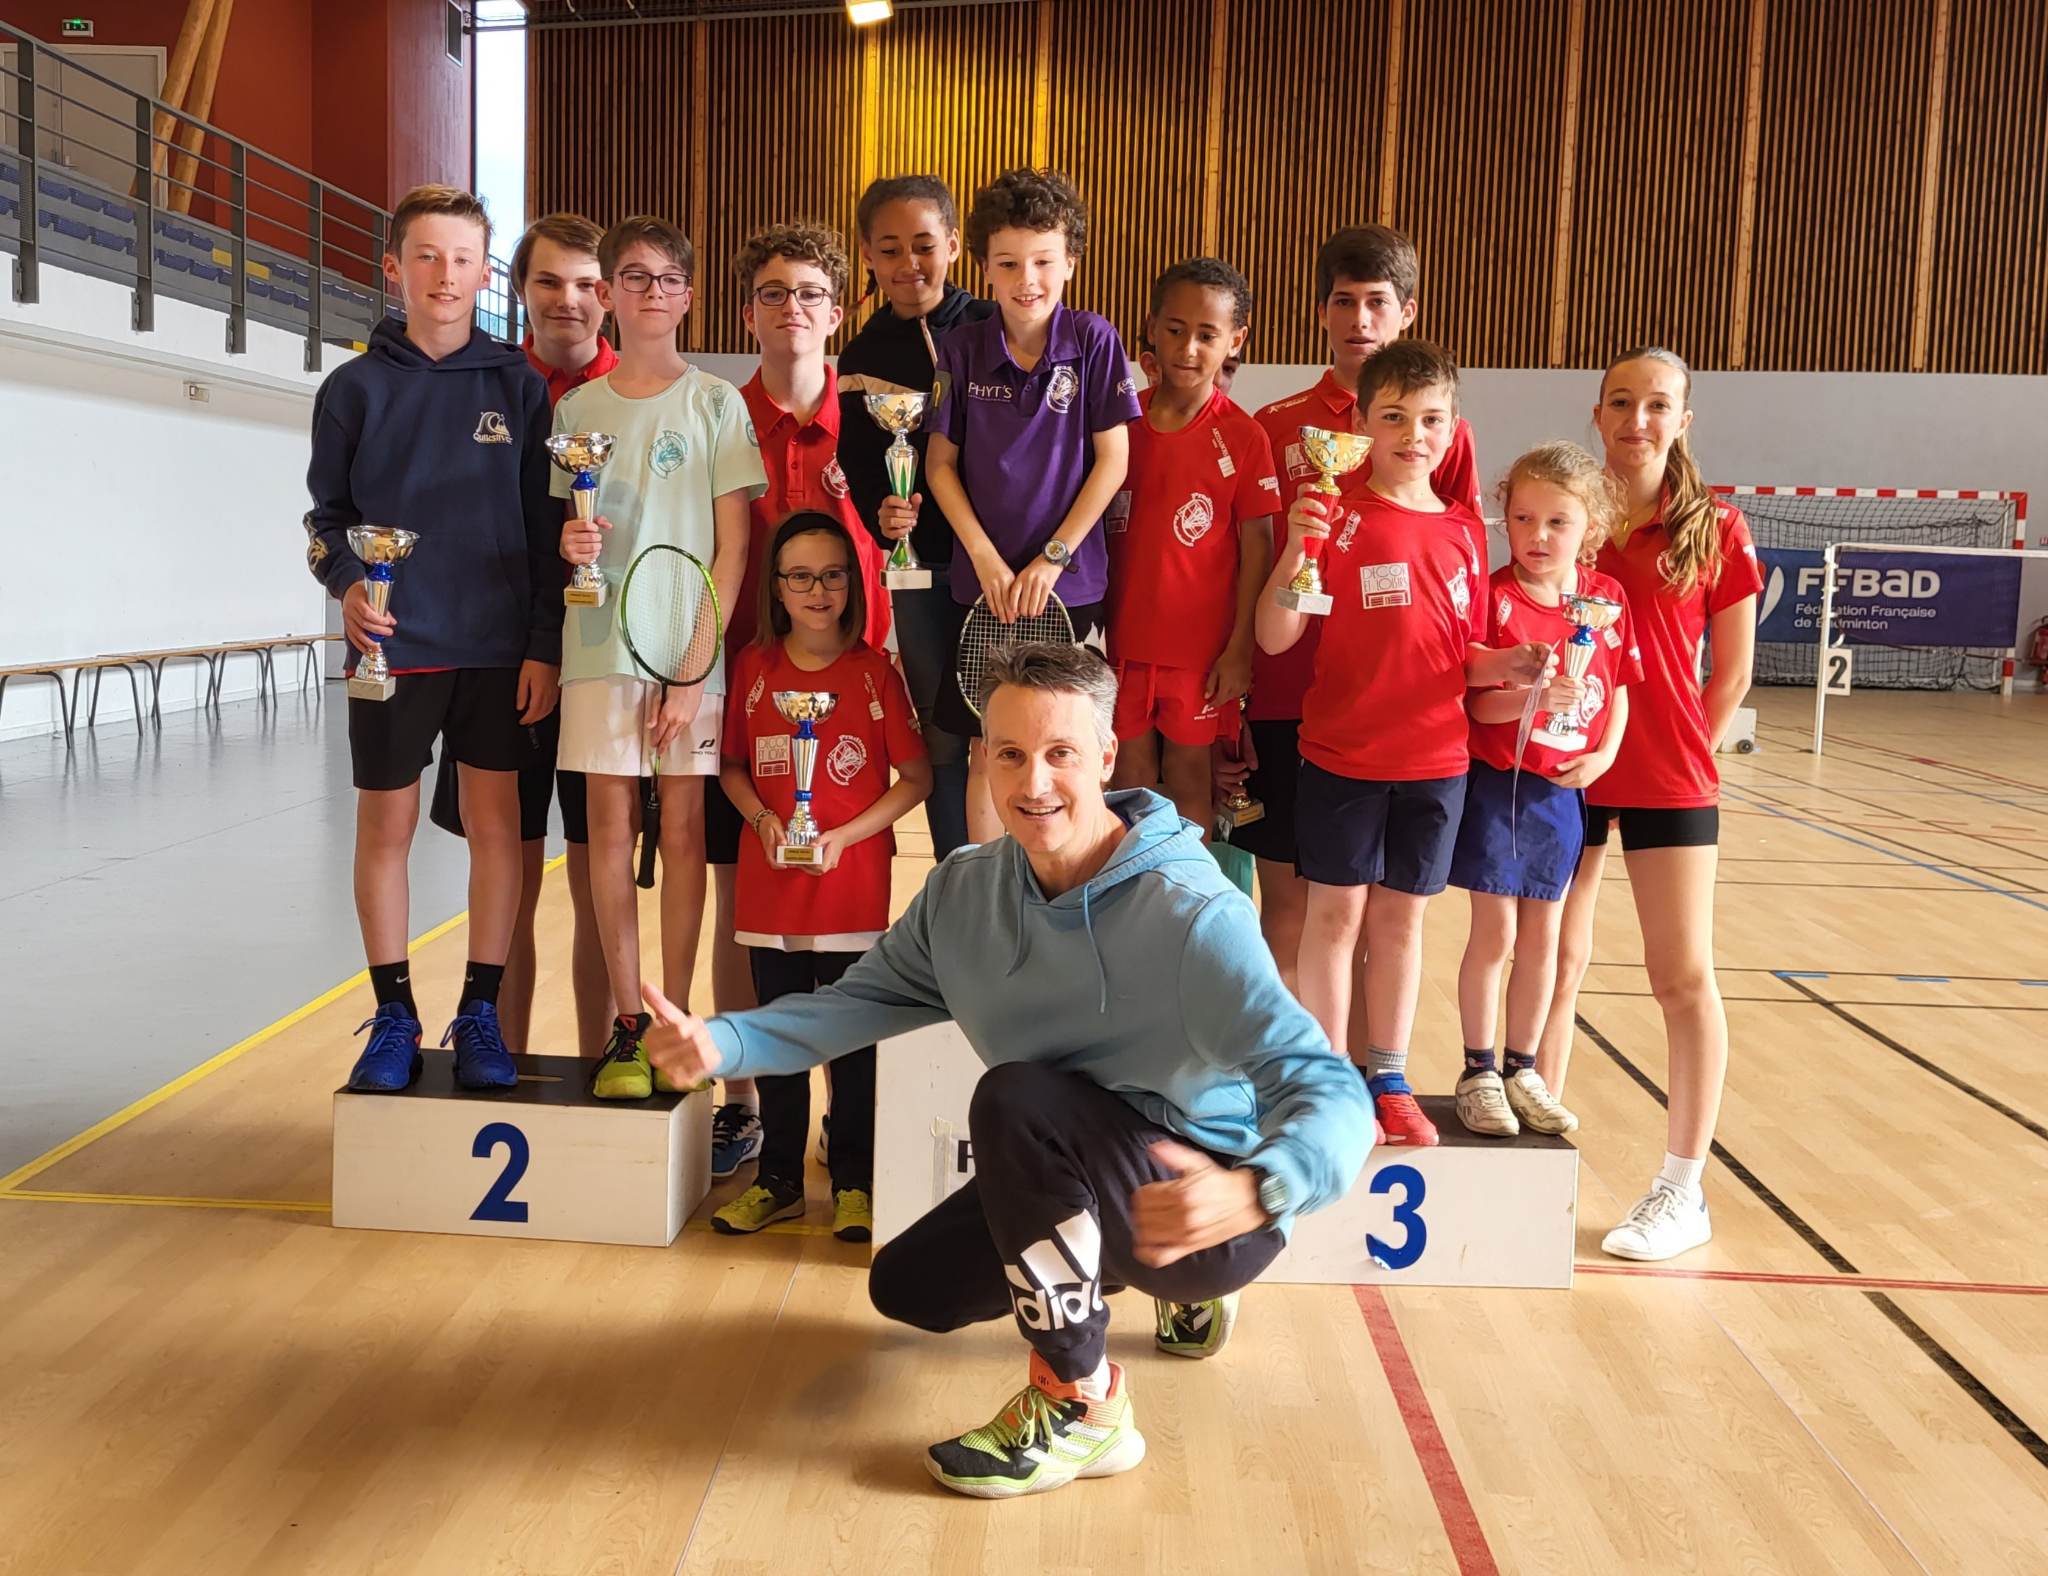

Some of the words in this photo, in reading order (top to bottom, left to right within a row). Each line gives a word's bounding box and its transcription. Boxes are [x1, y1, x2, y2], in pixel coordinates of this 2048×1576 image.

[968, 381, 1012, 399] PHYT'S
[1794, 617, 1812, 629] de
[1815, 617, 1888, 630] Bdminton
[1795, 602, 1867, 617] Fédation
[1871, 604, 1937, 619] Française
[1828, 655, 1847, 689] 2
[469, 1122, 529, 1223] 2
[1366, 1164, 1427, 1270] 3
